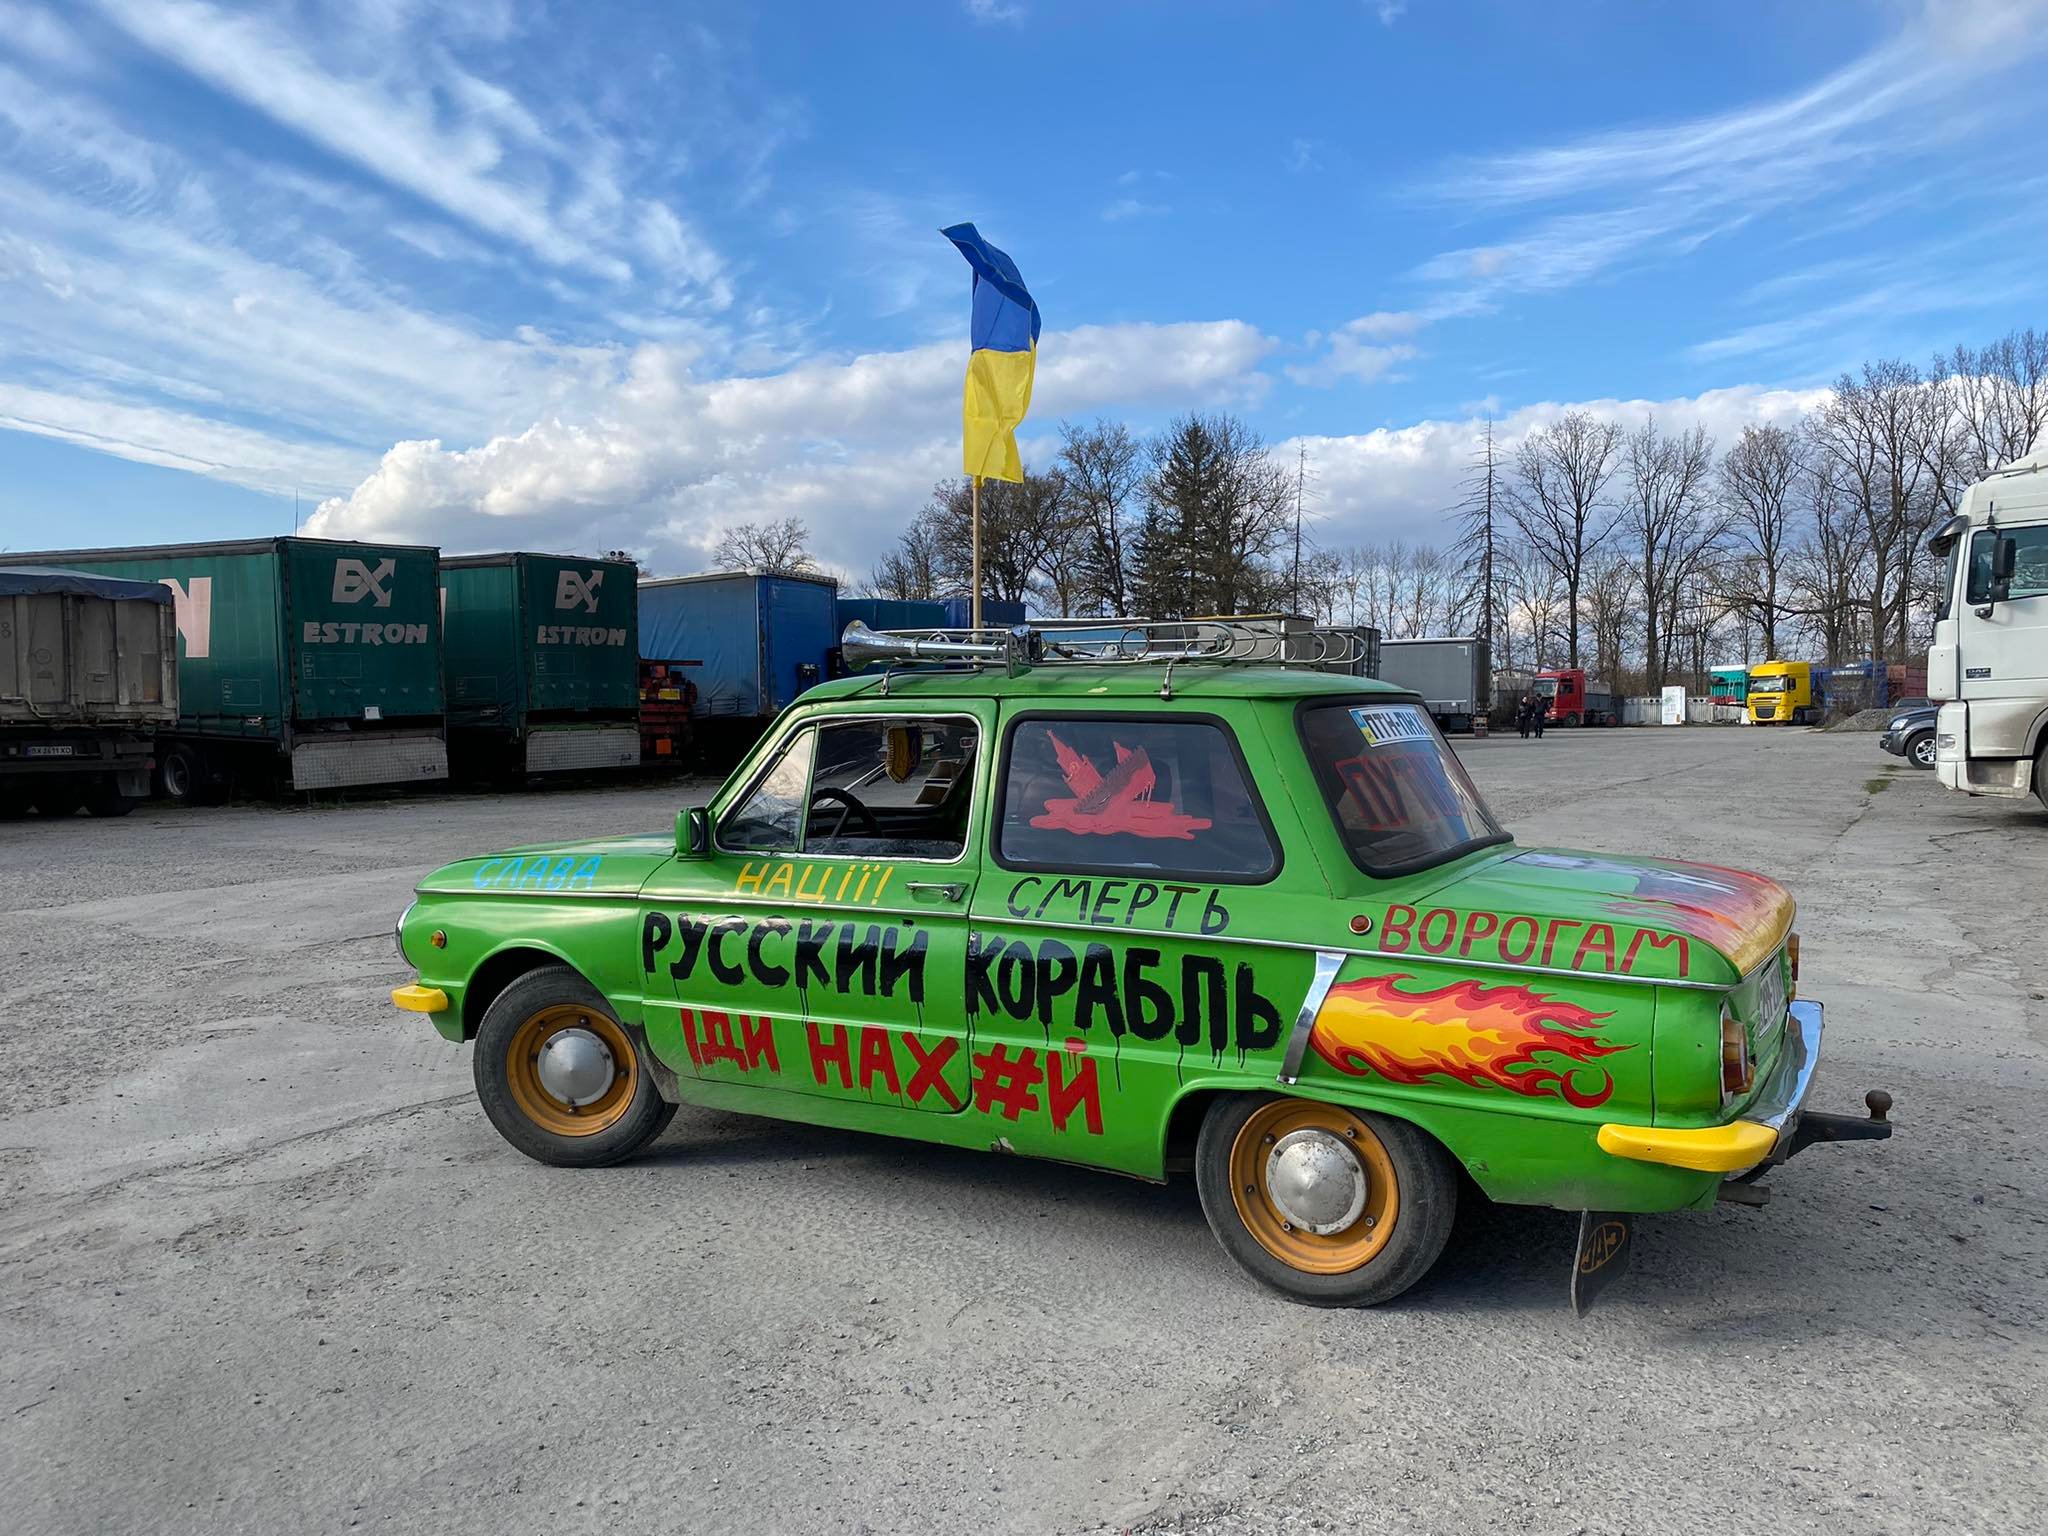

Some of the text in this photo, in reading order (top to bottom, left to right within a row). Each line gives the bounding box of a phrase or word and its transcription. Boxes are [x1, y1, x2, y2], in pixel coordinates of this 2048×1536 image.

[303, 621, 428, 646] ESTRON
[536, 625, 627, 647] ESTRON
[473, 855, 602, 890] СЛАВА
[1007, 876, 1230, 935] СМЕРТЬ
[1378, 904, 1690, 978] ВОРОГАМ
[642, 911, 1284, 1052] РУССКИЙ КОРАБЛЬ
[679, 1007, 1104, 1136] ІДИ НАХ#Й
